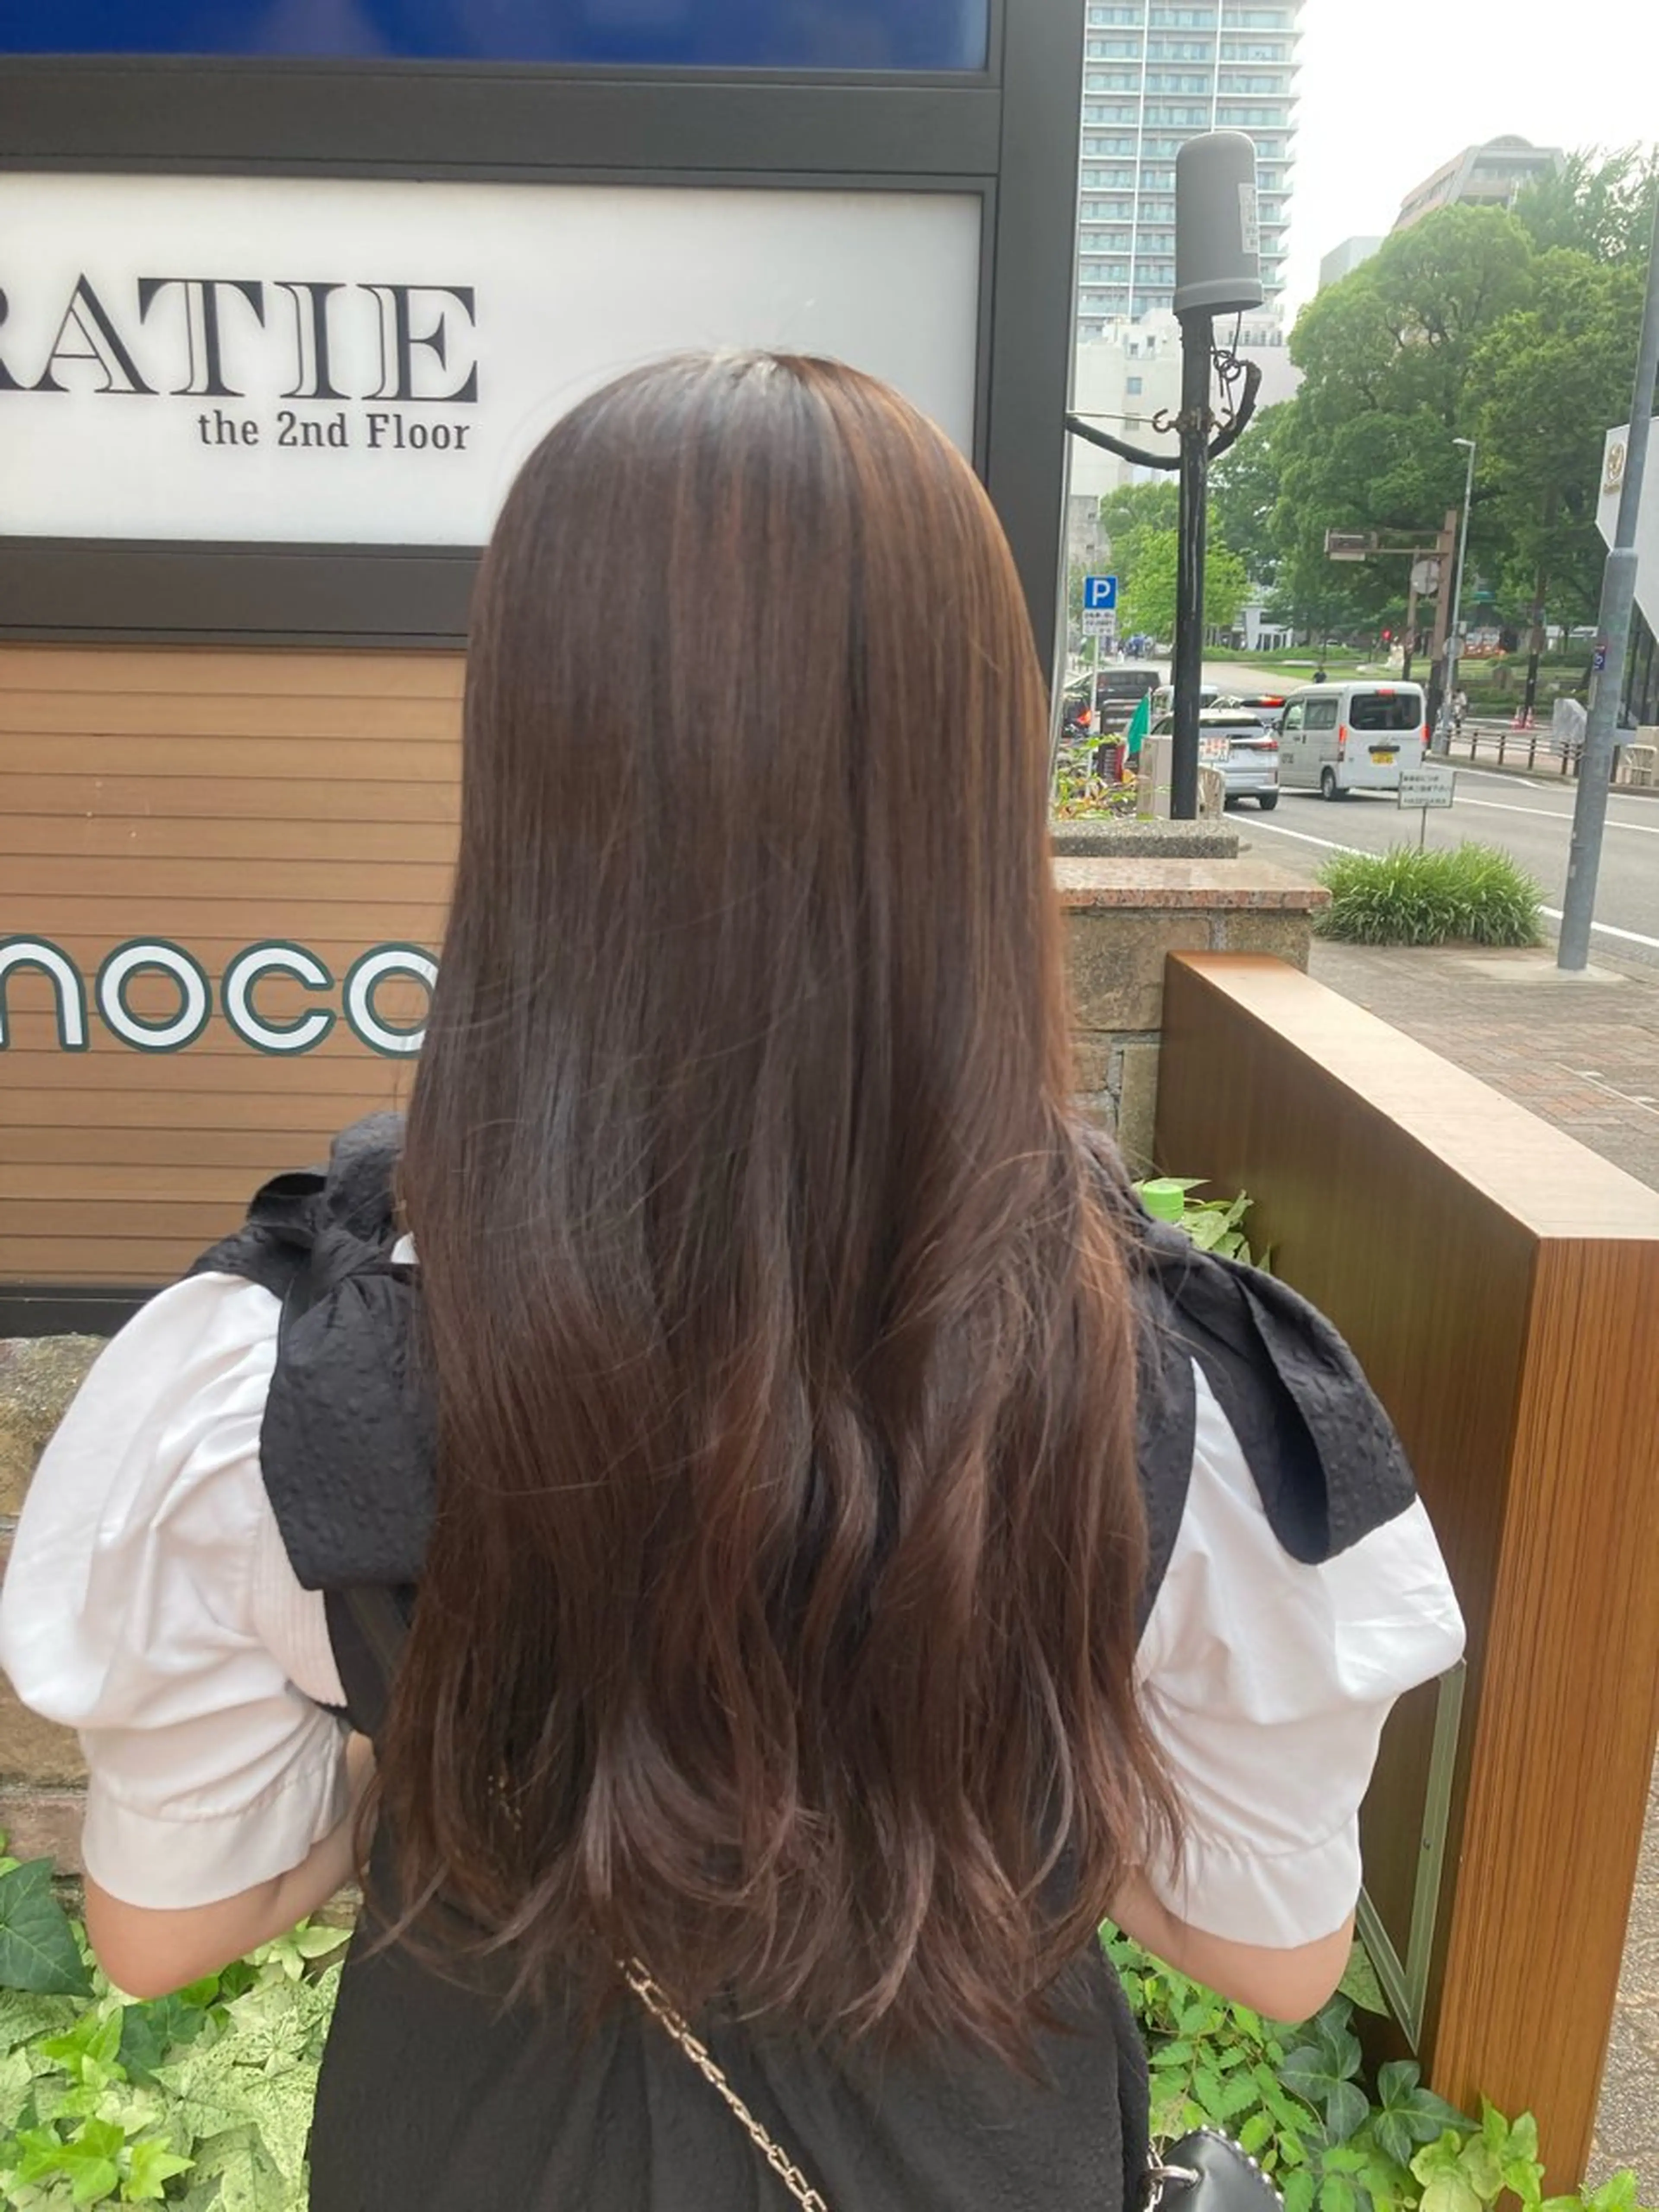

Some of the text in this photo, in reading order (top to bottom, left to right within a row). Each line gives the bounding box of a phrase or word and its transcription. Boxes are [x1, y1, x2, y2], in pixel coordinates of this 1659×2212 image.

[198, 409, 470, 450] the 2nd Floor
[1092, 579, 1111, 606] P
